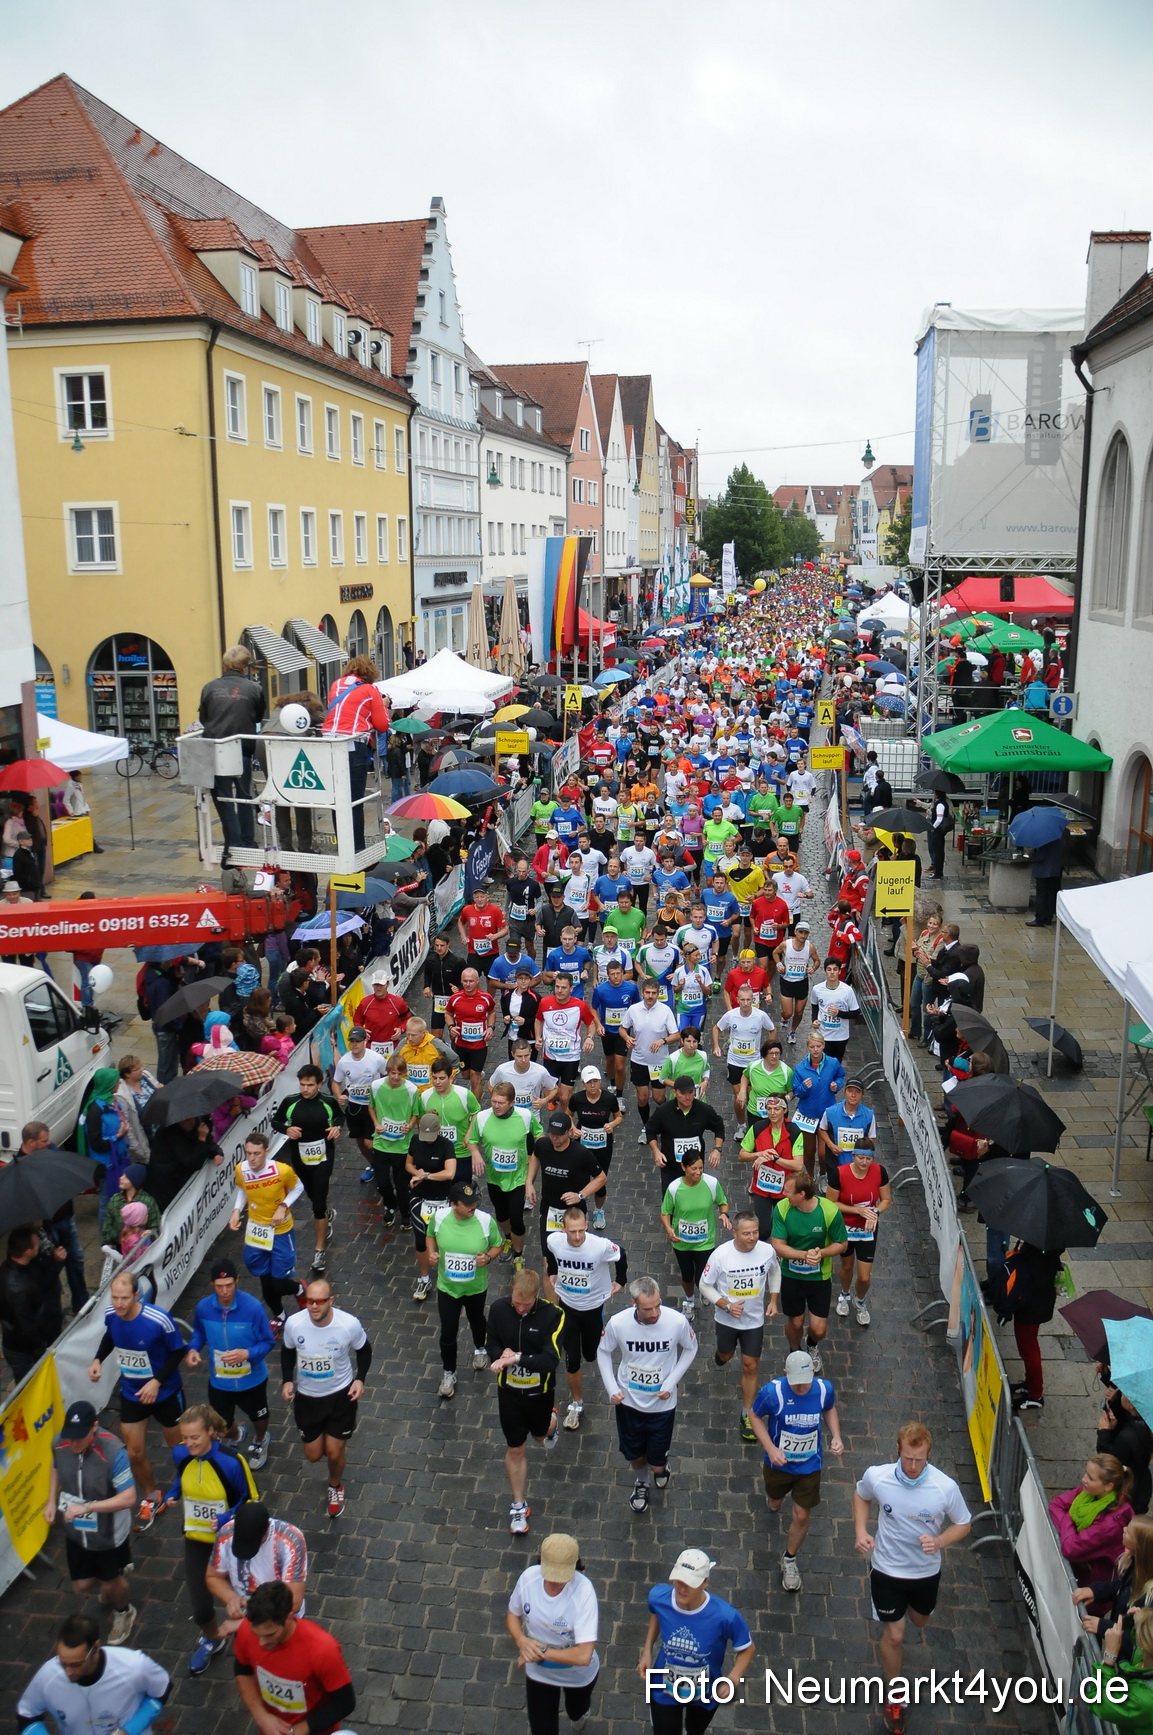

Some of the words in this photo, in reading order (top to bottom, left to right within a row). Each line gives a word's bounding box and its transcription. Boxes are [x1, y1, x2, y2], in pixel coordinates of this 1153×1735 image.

[687, 499, 695, 542] HOTEL
[1006, 522, 1078, 534] www.barow
[568, 693, 578, 704] A
[822, 708, 831, 721] A
[878, 876, 914, 887] Jugend-
[887, 886, 904, 896] lauf
[0, 922, 94, 939] Serviceline:
[99, 917, 145, 932] 09181
[149, 913, 189, 928] 6352
[464, 1027, 482, 1035] 3001
[549, 1040, 568, 1048] 2127
[408, 1069, 428, 1078] 3002
[583, 1132, 604, 1141] 2556
[843, 1134, 859, 1142] 548
[305, 1147, 322, 1156] 468
[494, 1153, 516, 1164] 2832
[760, 1171, 782, 1184] 2634
[246, 1182, 260, 1190] MAX
[262, 1178, 282, 1188] BÖGL
[251, 1227, 268, 1238] 486
[682, 1225, 705, 1234] 2835
[162, 1210, 195, 1270] BMW
[164, 1245, 194, 1290] Weniger
[448, 1260, 474, 1271] 2836
[556, 1258, 594, 1271] THULE
[561, 1275, 588, 1287] 2425
[734, 1278, 754, 1289] 254
[626, 1341, 669, 1352] THULE
[301, 1360, 330, 1371] 2185
[631, 1371, 660, 1384] 2423
[785, 1413, 820, 1425] HUBER
[783, 1439, 815, 1451] 2777
[193, 1504, 216, 1520] 586
[266, 1680, 294, 1700] 324
